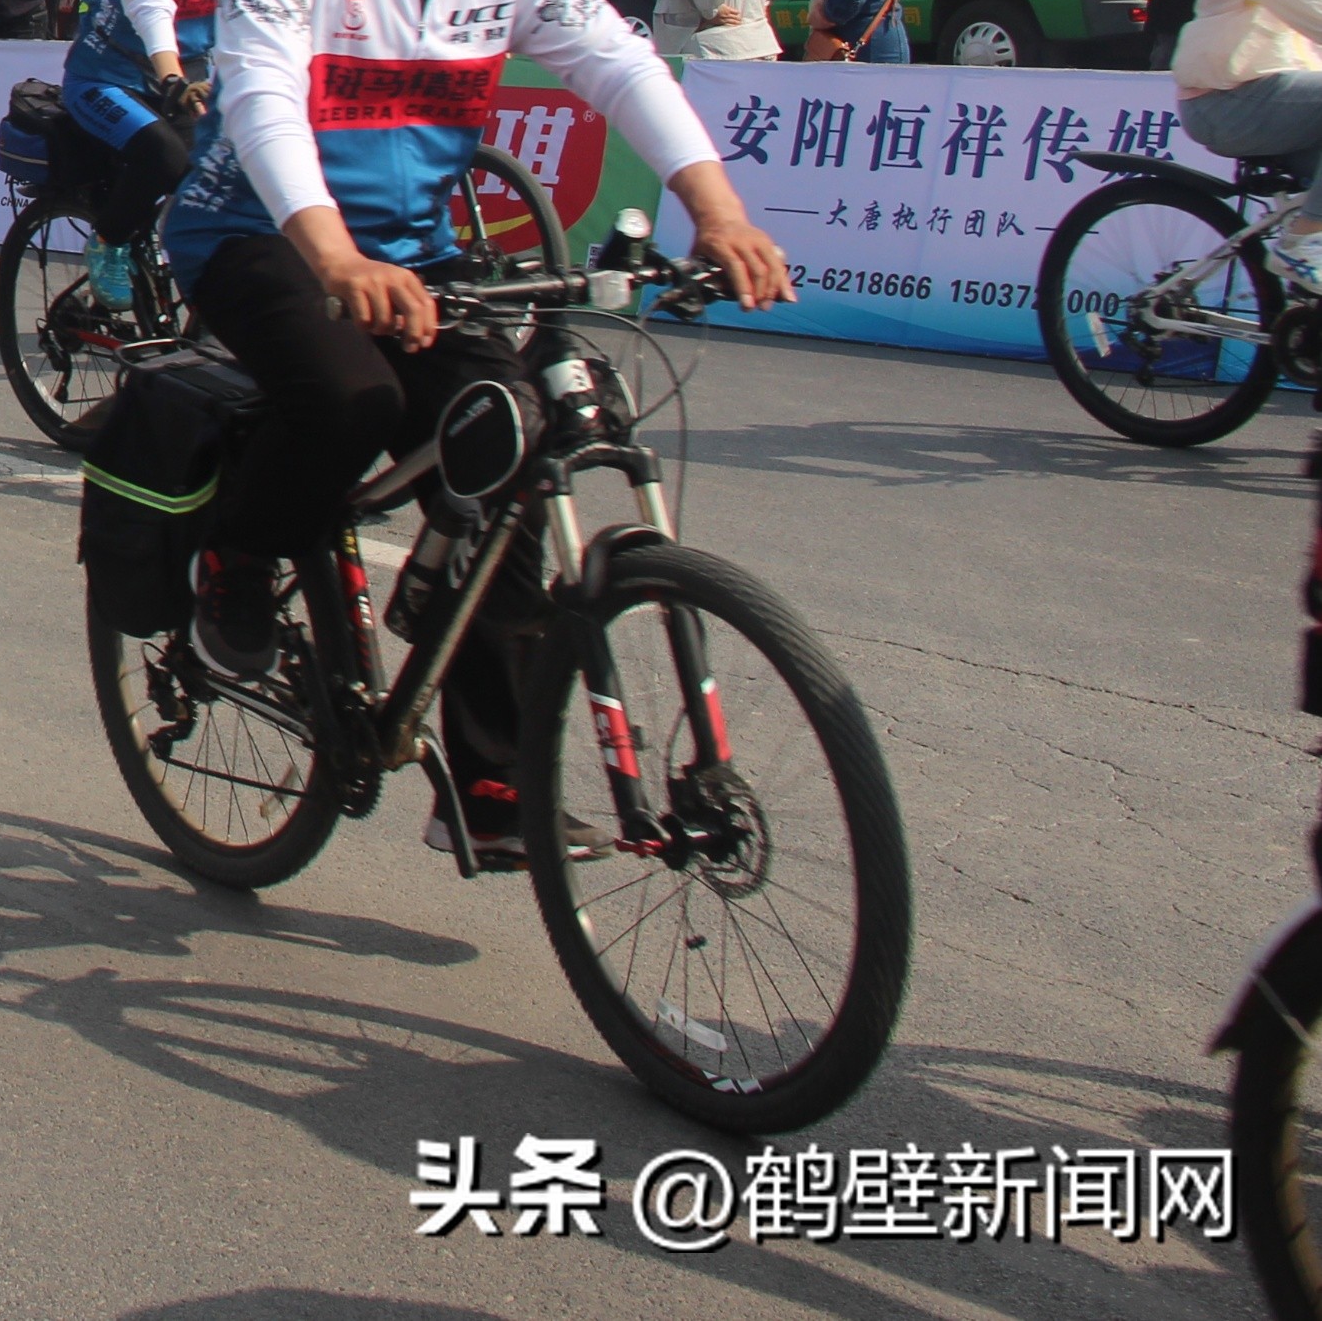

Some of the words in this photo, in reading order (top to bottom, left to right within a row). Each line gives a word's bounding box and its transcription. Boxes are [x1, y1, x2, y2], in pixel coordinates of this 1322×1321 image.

[448, 2, 516, 26] UCC
[319, 106, 393, 123] ZEBRA
[402, 104, 486, 126] CRAFT
[722, 94, 1181, 184] 安阳恒祥传媒
[826, 198, 1024, 237] 大唐执行团队
